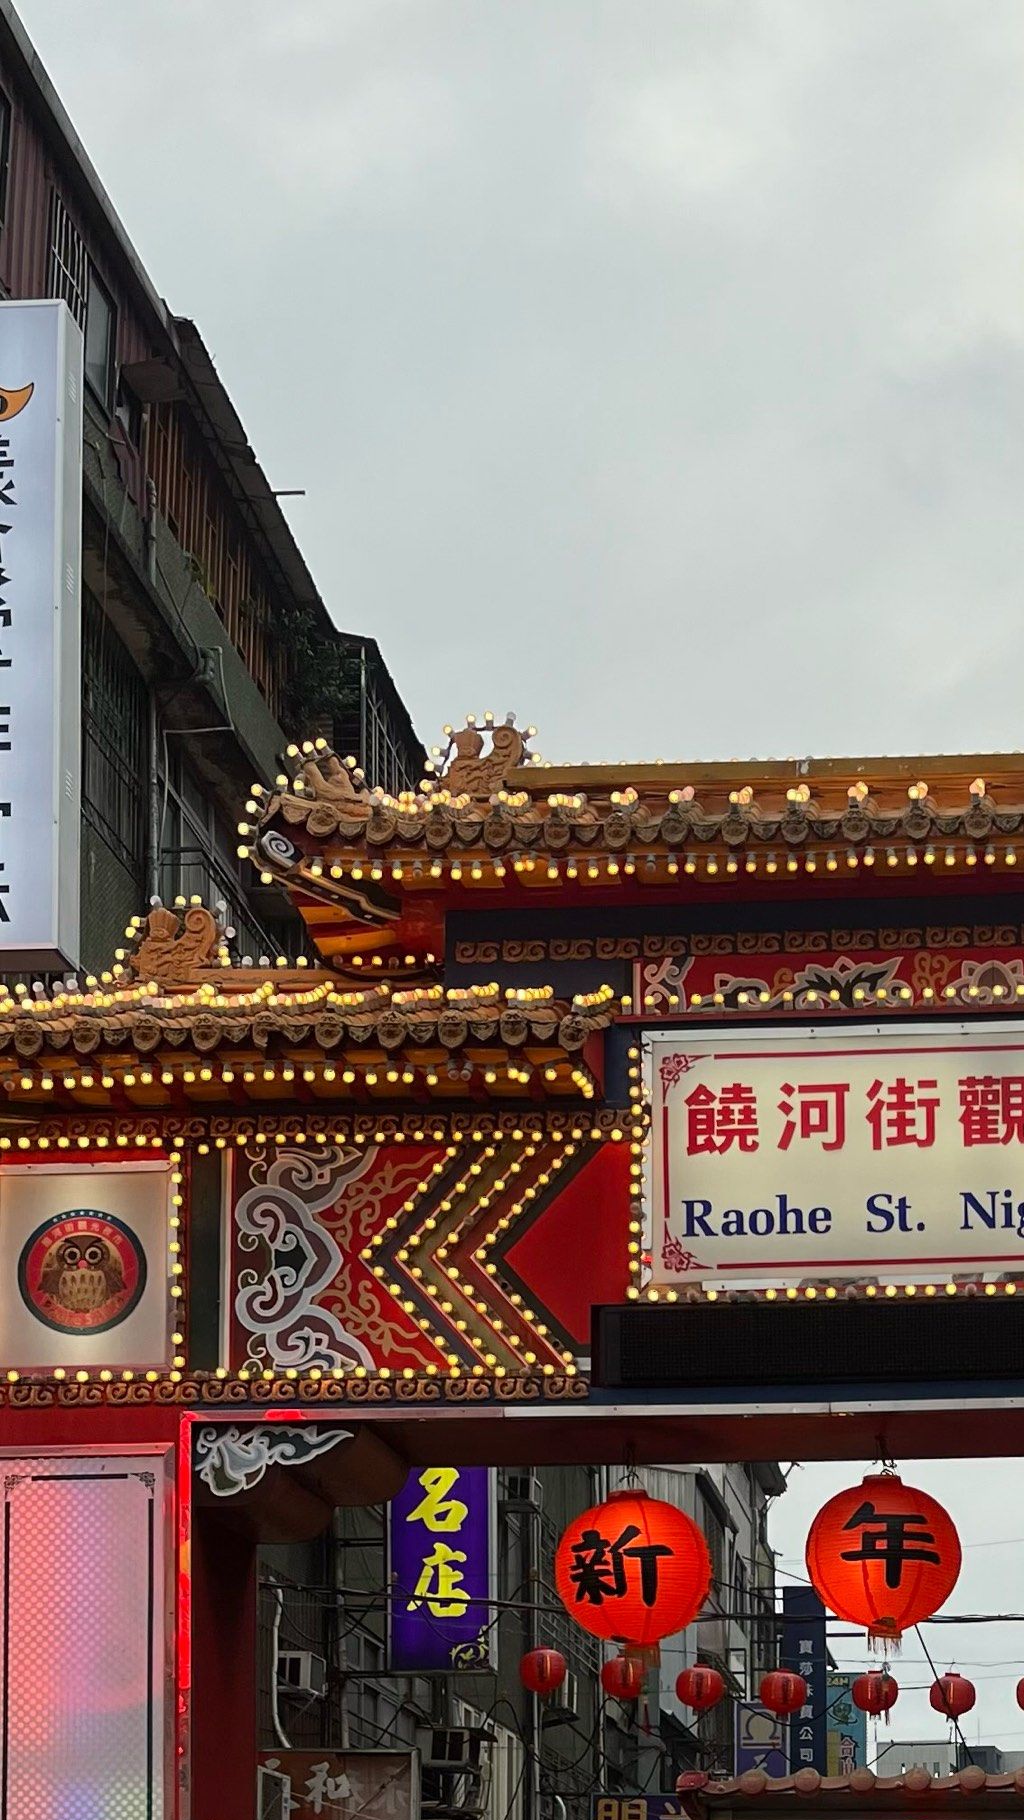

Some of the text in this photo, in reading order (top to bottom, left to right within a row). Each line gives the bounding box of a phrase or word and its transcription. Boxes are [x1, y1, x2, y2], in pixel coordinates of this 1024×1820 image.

[681, 1194, 832, 1239] Raohe
[866, 1193, 927, 1235] St.
[406, 1467, 471, 1619] 名店
[570, 1525, 674, 1608] 新
[840, 1501, 942, 1589] 年
